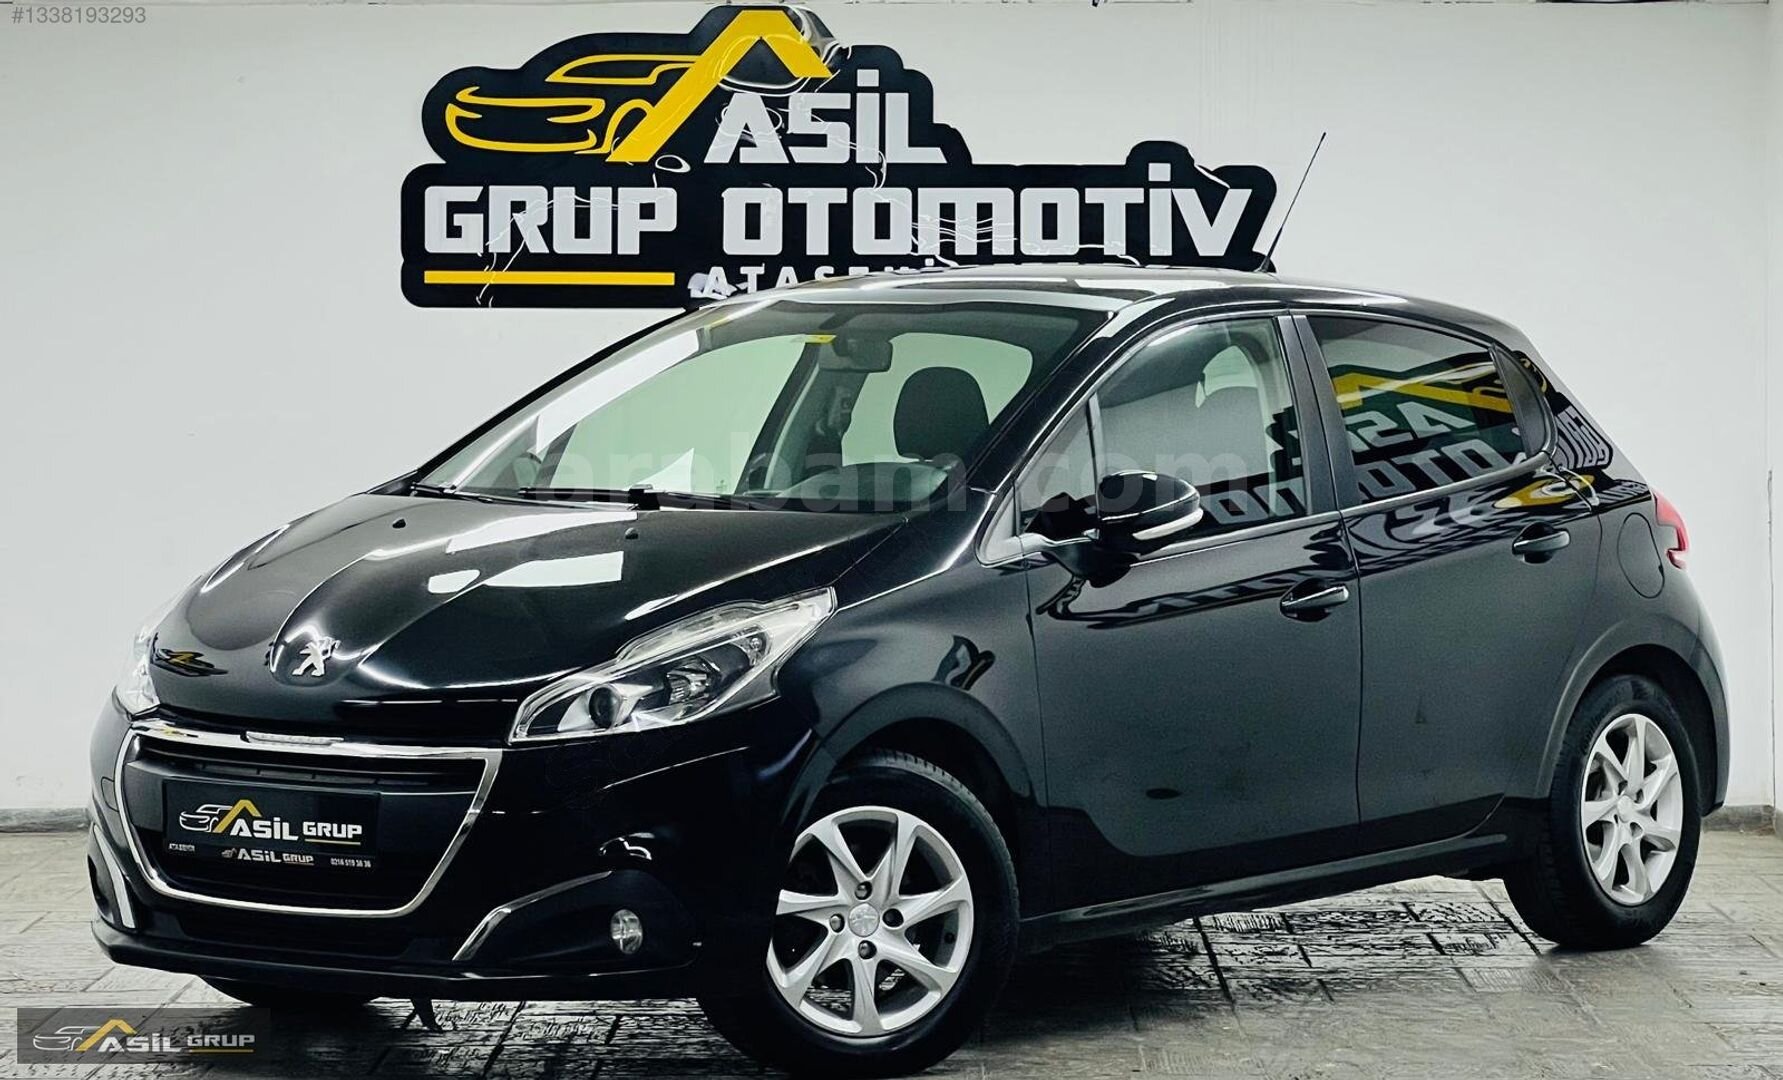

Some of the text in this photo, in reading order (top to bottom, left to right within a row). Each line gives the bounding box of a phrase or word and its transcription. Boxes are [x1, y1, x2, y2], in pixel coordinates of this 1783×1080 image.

[703, 69, 946, 165] ASİL
[424, 162, 1253, 257] GRUP OTOMOTİV
[229, 816, 363, 841] ASİL GRUP
[282, 853, 314, 864] GRUP
